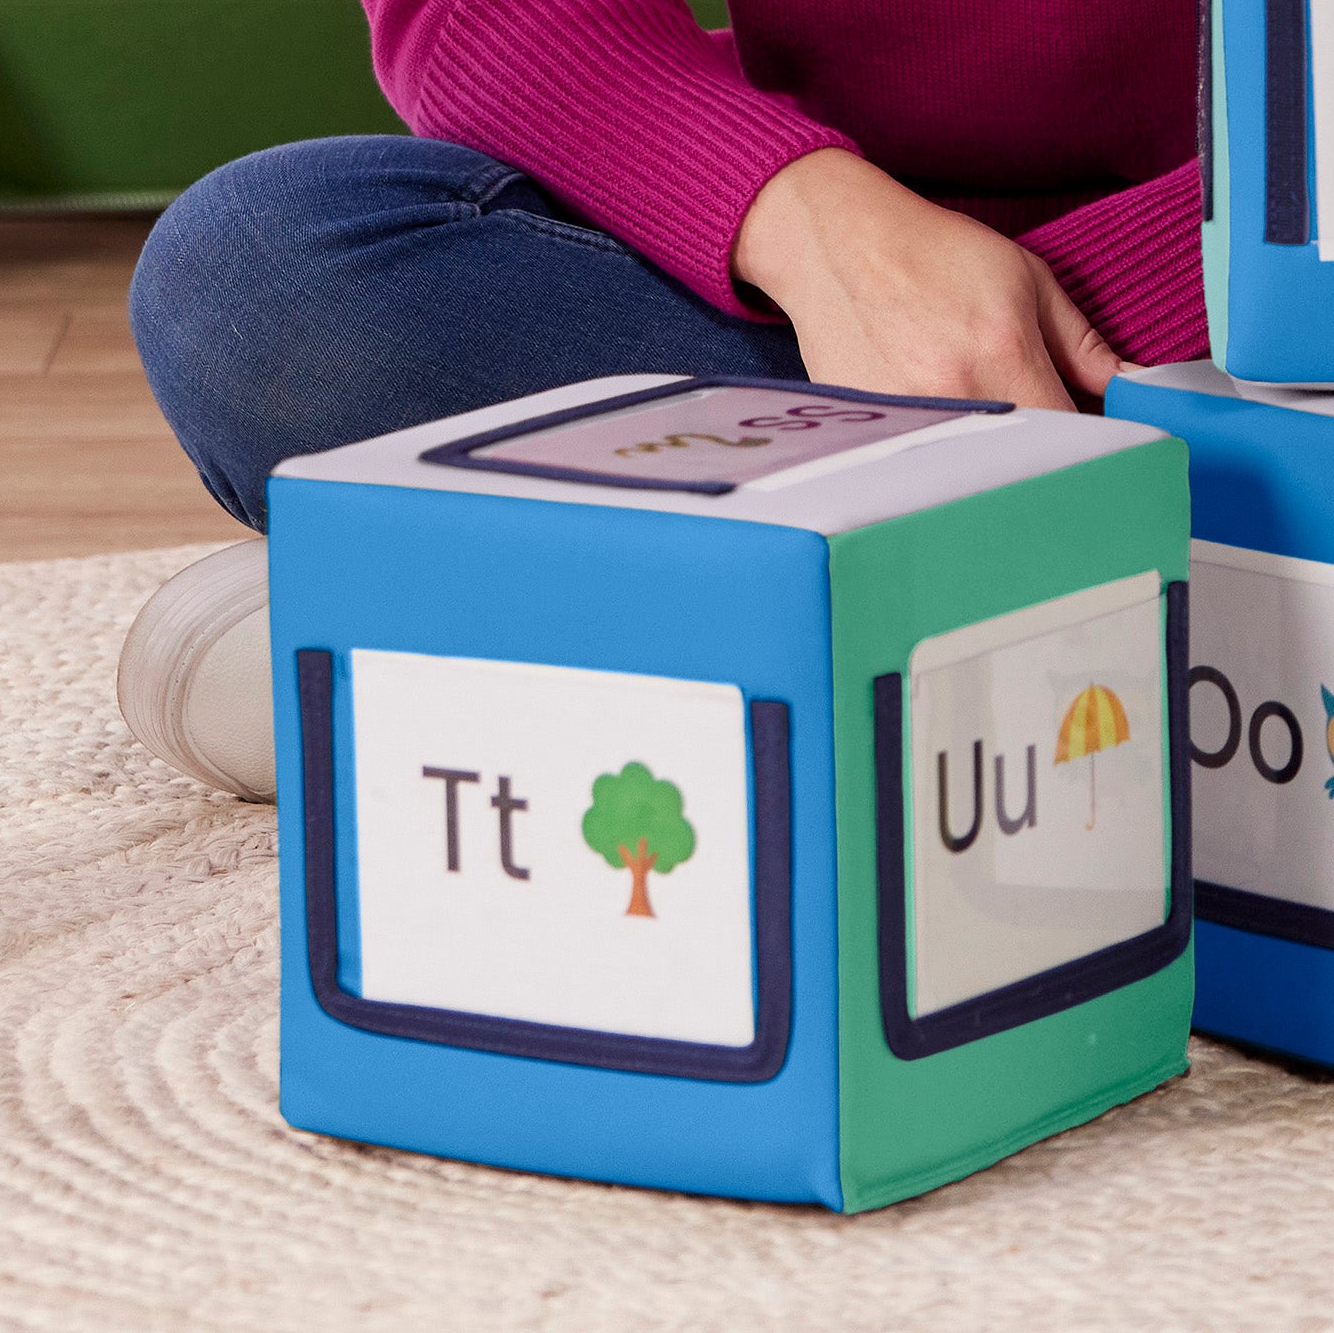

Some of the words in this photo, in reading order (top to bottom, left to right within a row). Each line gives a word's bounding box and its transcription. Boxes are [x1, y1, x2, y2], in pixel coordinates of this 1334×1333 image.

[1188, 663, 1304, 785] Oo
[422, 765, 531, 882] Tt
[937, 738, 1037, 855] Uu
